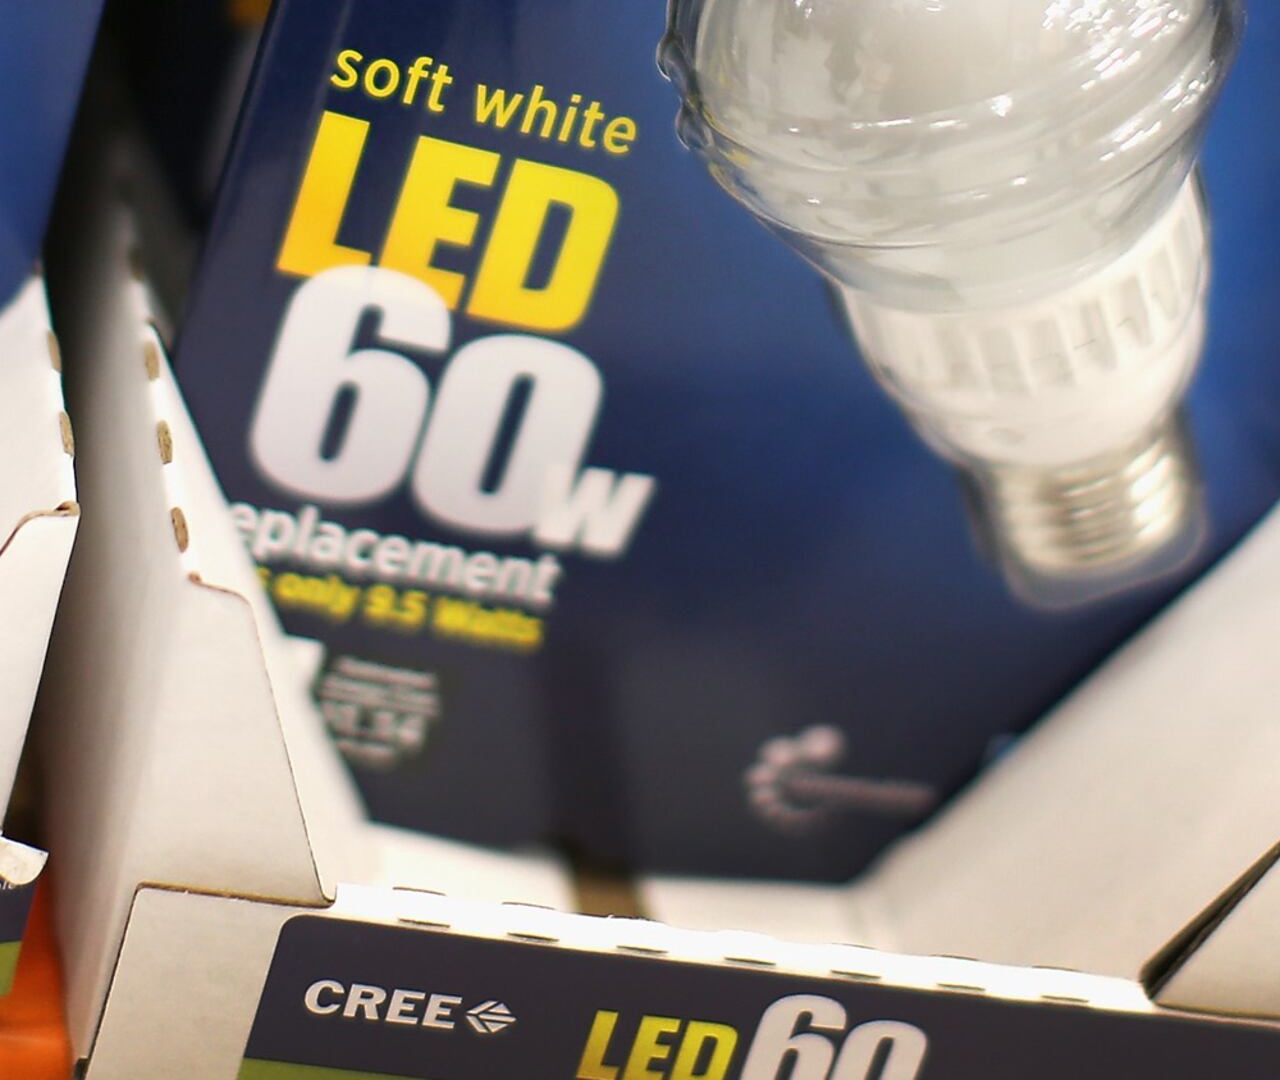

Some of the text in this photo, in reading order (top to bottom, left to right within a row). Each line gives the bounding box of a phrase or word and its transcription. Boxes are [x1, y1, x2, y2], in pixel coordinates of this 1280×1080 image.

[330, 47, 637, 156] soft white
[276, 111, 618, 332] LED
[230, 502, 561, 607] eplacement
[304, 979, 462, 1030] CREE
[576, 1010, 738, 1080] LED
